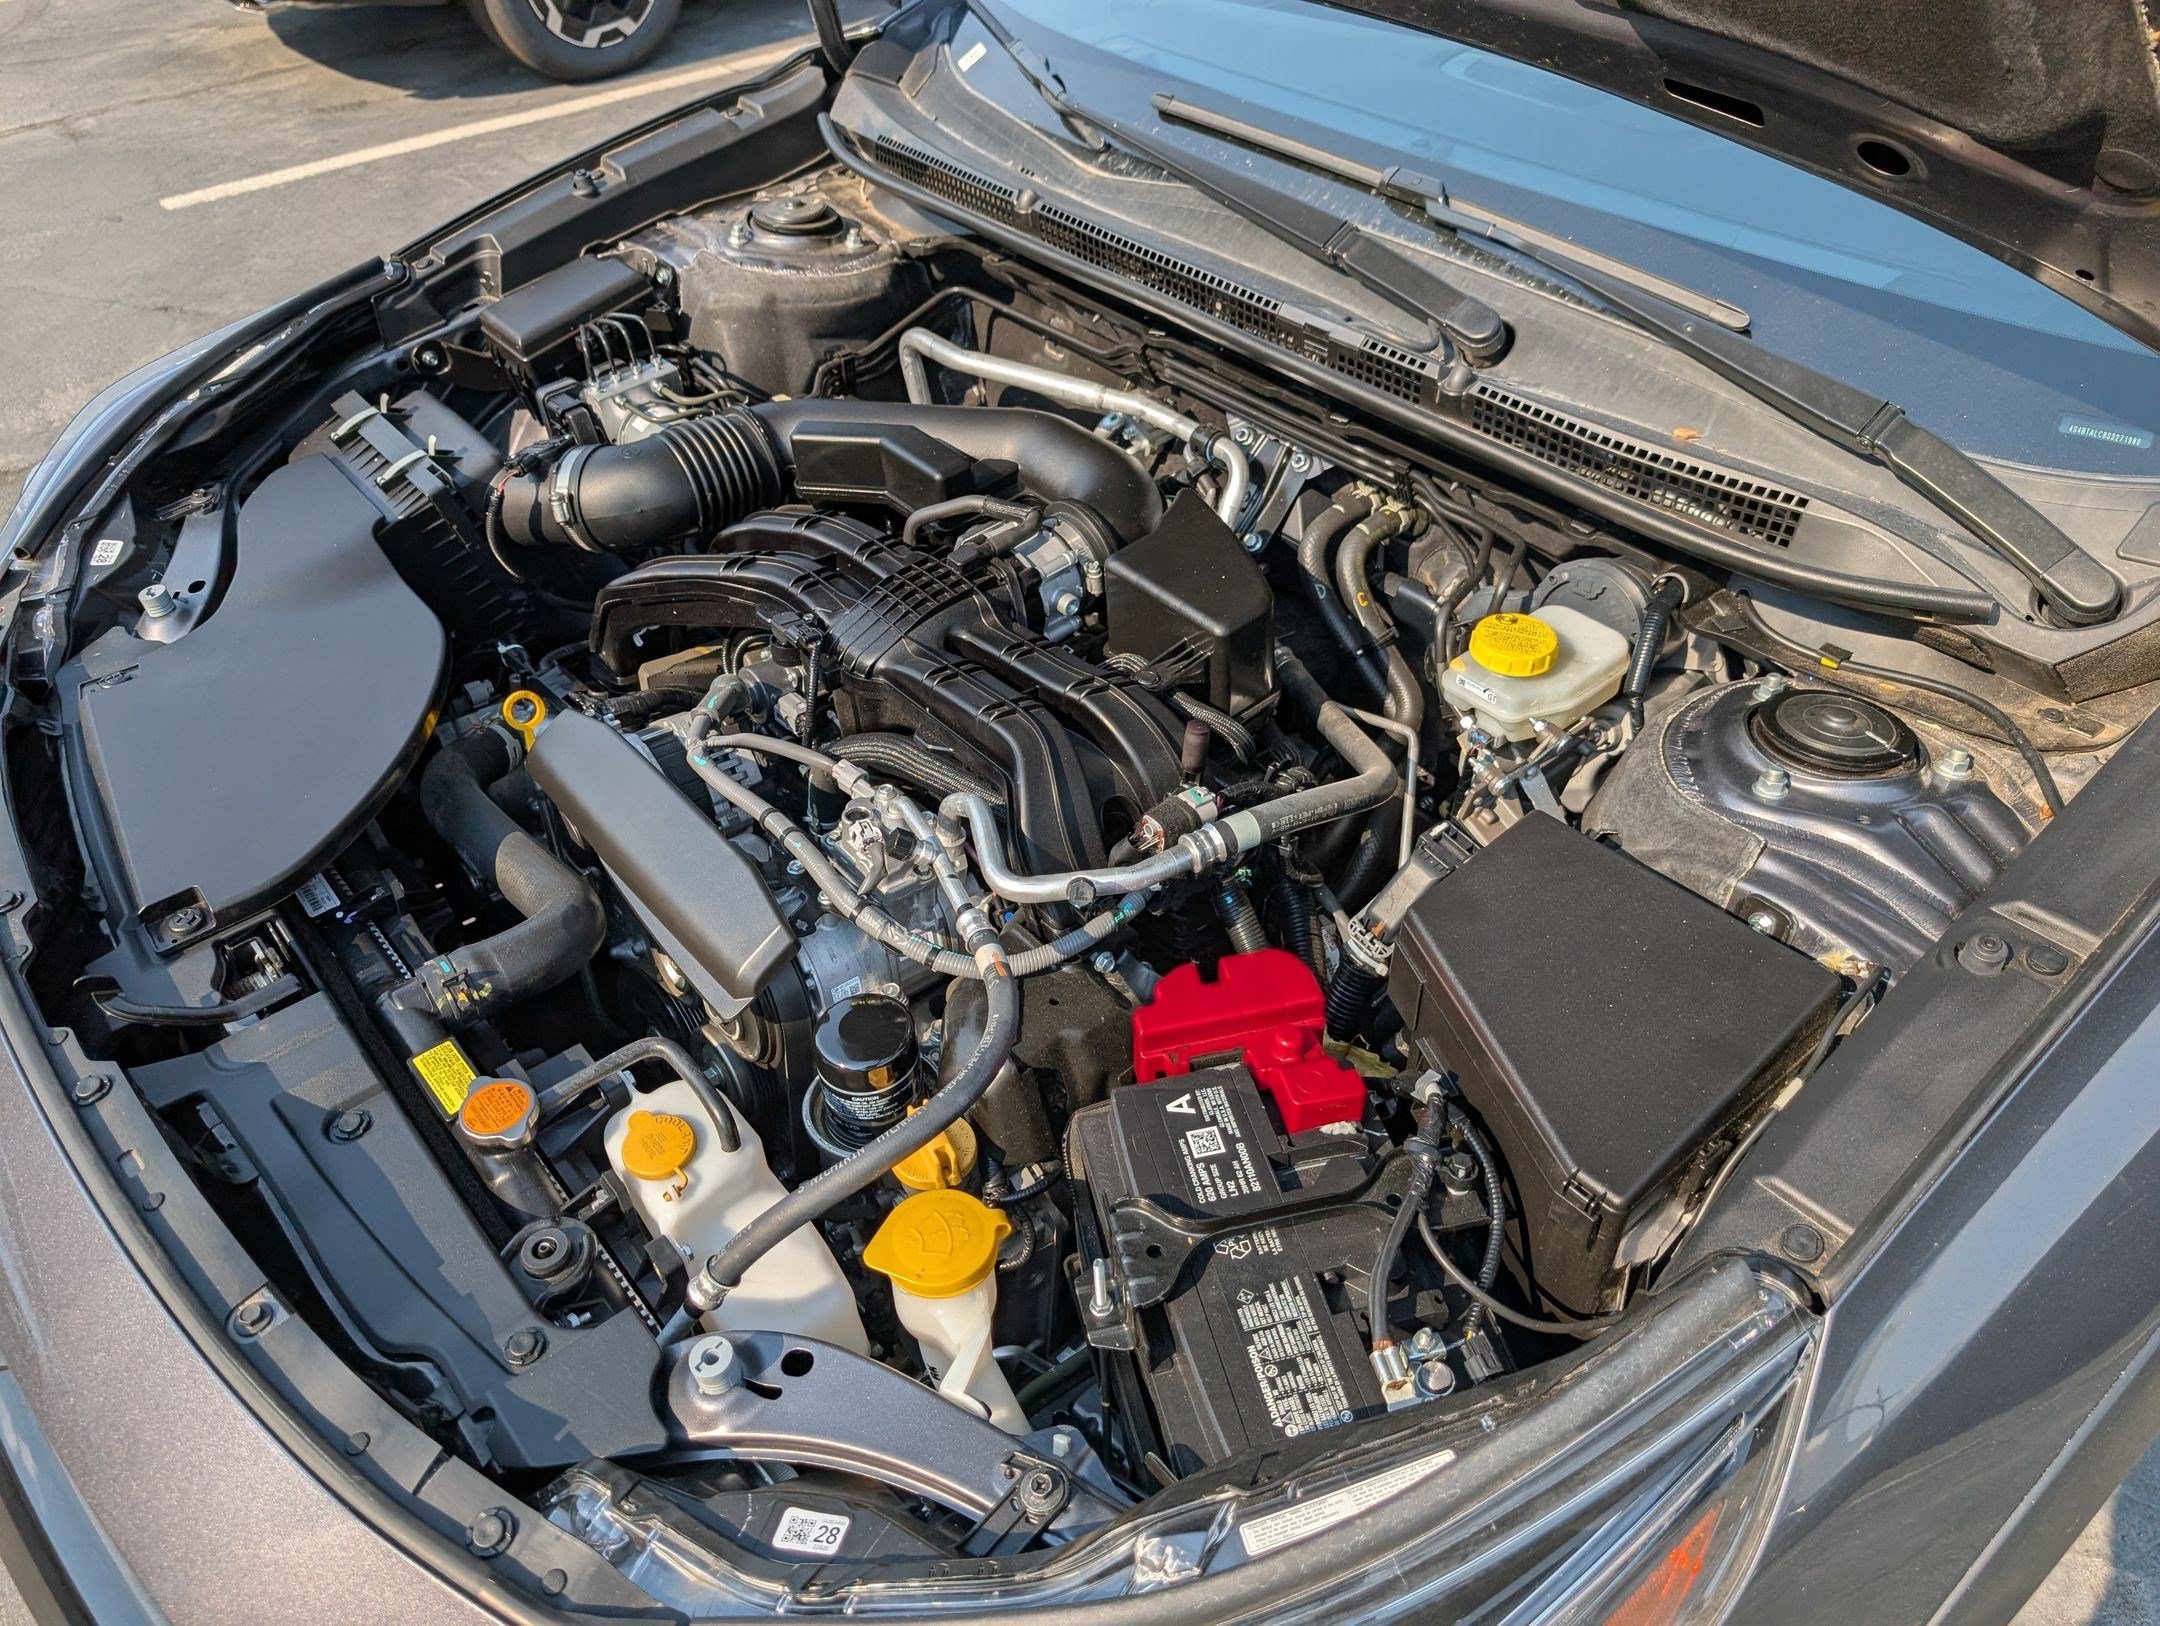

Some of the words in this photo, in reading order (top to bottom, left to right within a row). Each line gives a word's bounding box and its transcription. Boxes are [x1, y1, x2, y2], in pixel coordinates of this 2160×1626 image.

[96, 553, 110, 563] 28
[1314, 583, 1327, 600] D
[1166, 1094, 1196, 1114] A
[1179, 1139, 1189, 1154] AMPS
[1185, 1156, 1199, 1186] CRANKING
[1210, 1164, 1219, 1177] SIZE
[1232, 1161, 1240, 1169] AH
[1236, 1143, 1261, 1191] 82110AN00B
[1196, 1163, 1211, 1185] AMPS
[1195, 1187, 1205, 1203] COLD
[1205, 1187, 1216, 1201] 620
[1215, 1178, 1227, 1198] GROUP
[1226, 1181, 1238, 1196] LN2
[1247, 1345, 1279, 1418] DANGER/POISON
[813, 1524, 841, 1545] 28
